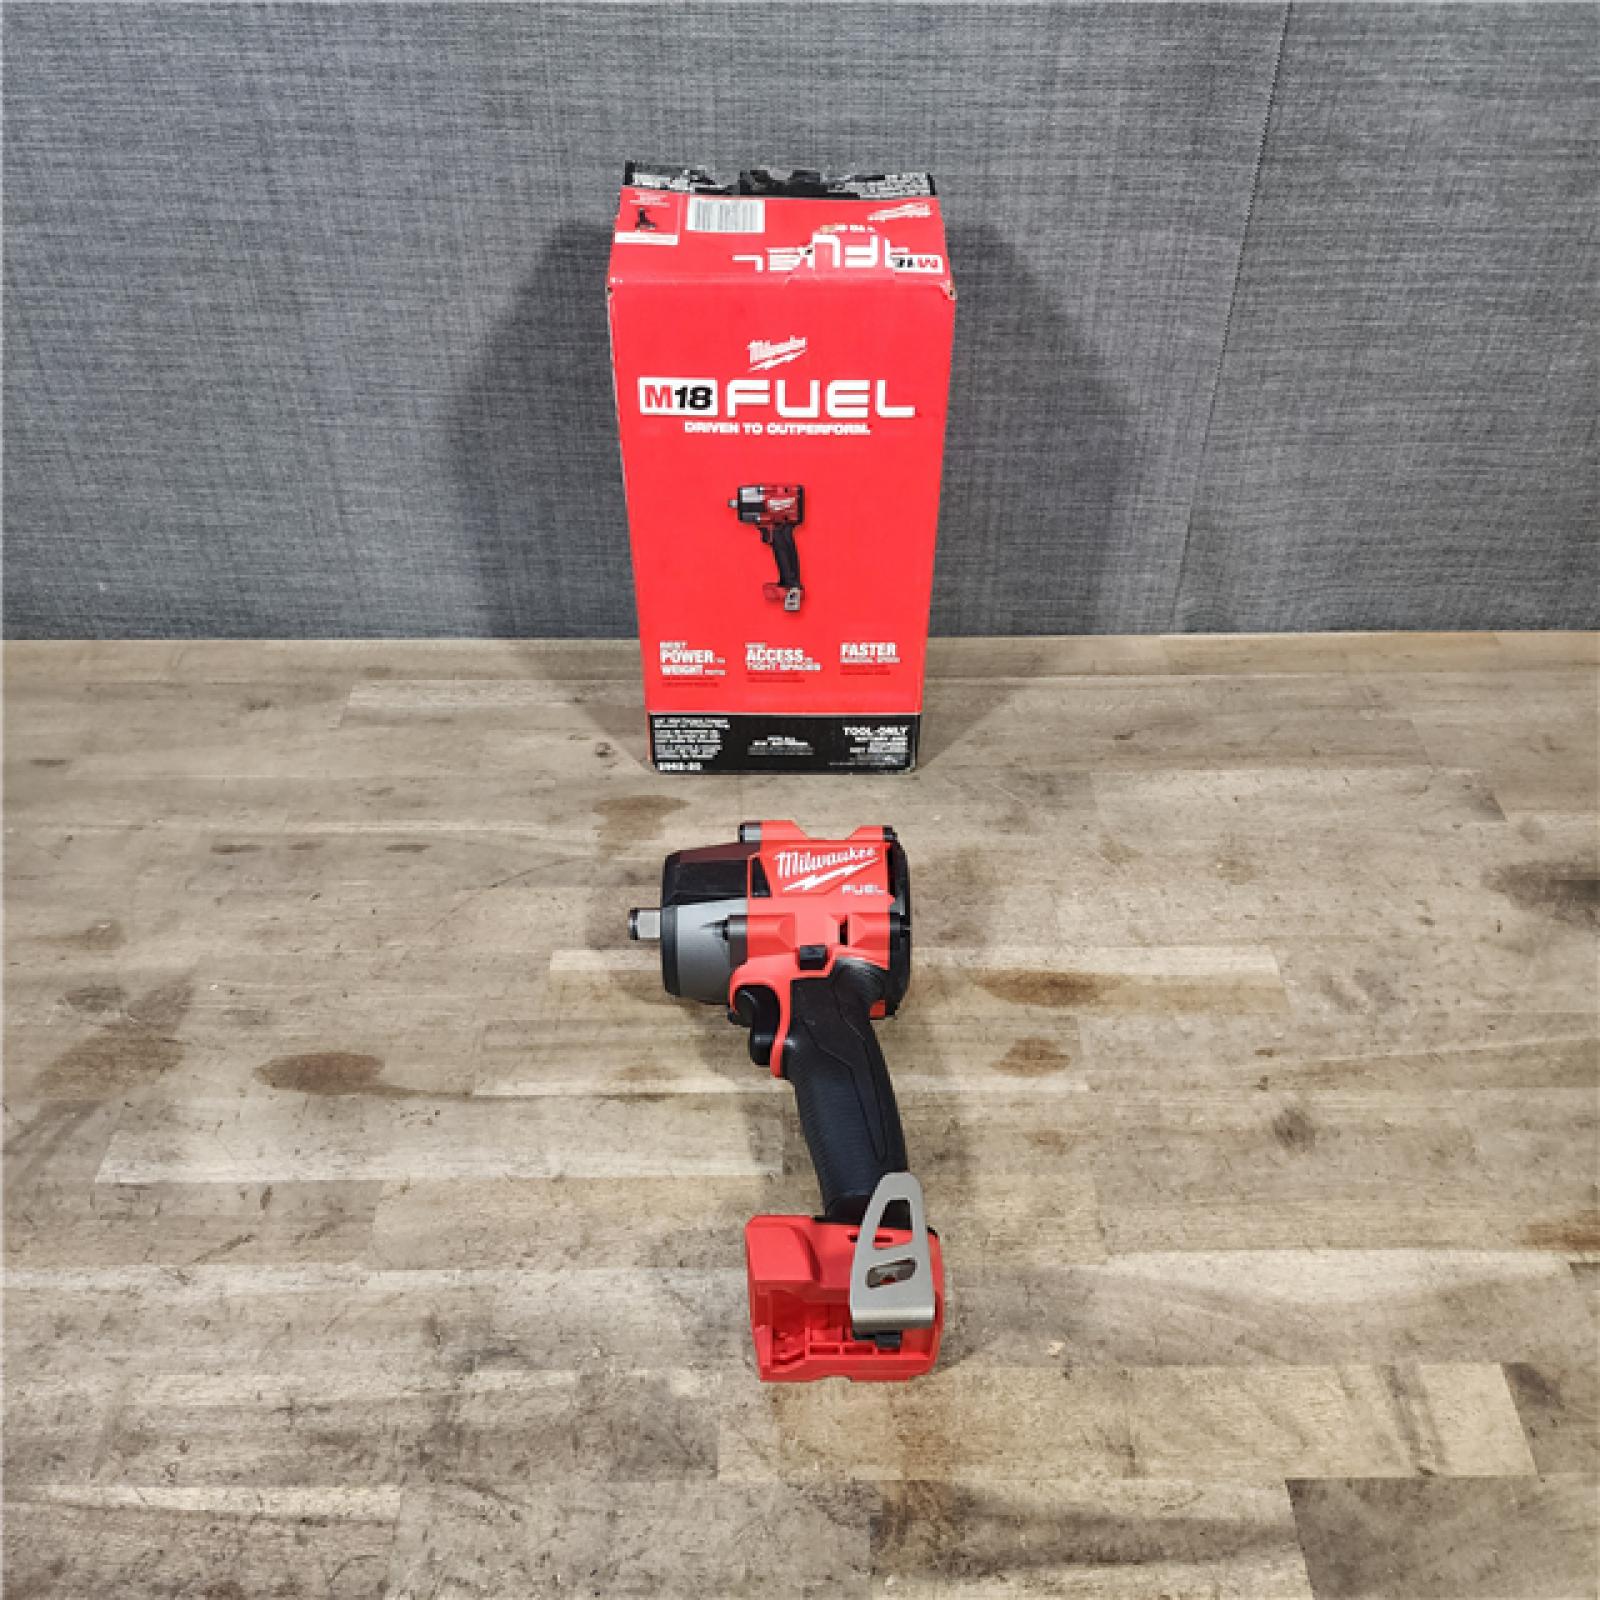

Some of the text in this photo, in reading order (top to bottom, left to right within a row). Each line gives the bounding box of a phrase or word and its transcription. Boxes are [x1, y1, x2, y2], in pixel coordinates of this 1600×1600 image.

[643, 379, 916, 418] M18 FUEL
[684, 421, 740, 434] DRIVEN
[743, 422, 763, 434] TO
[746, 648, 804, 661] ACCESS
[840, 642, 897, 656] FASTER
[660, 650, 714, 664] POWER
[773, 847, 876, 879] Milwaukee
[841, 884, 886, 896] FUEL
